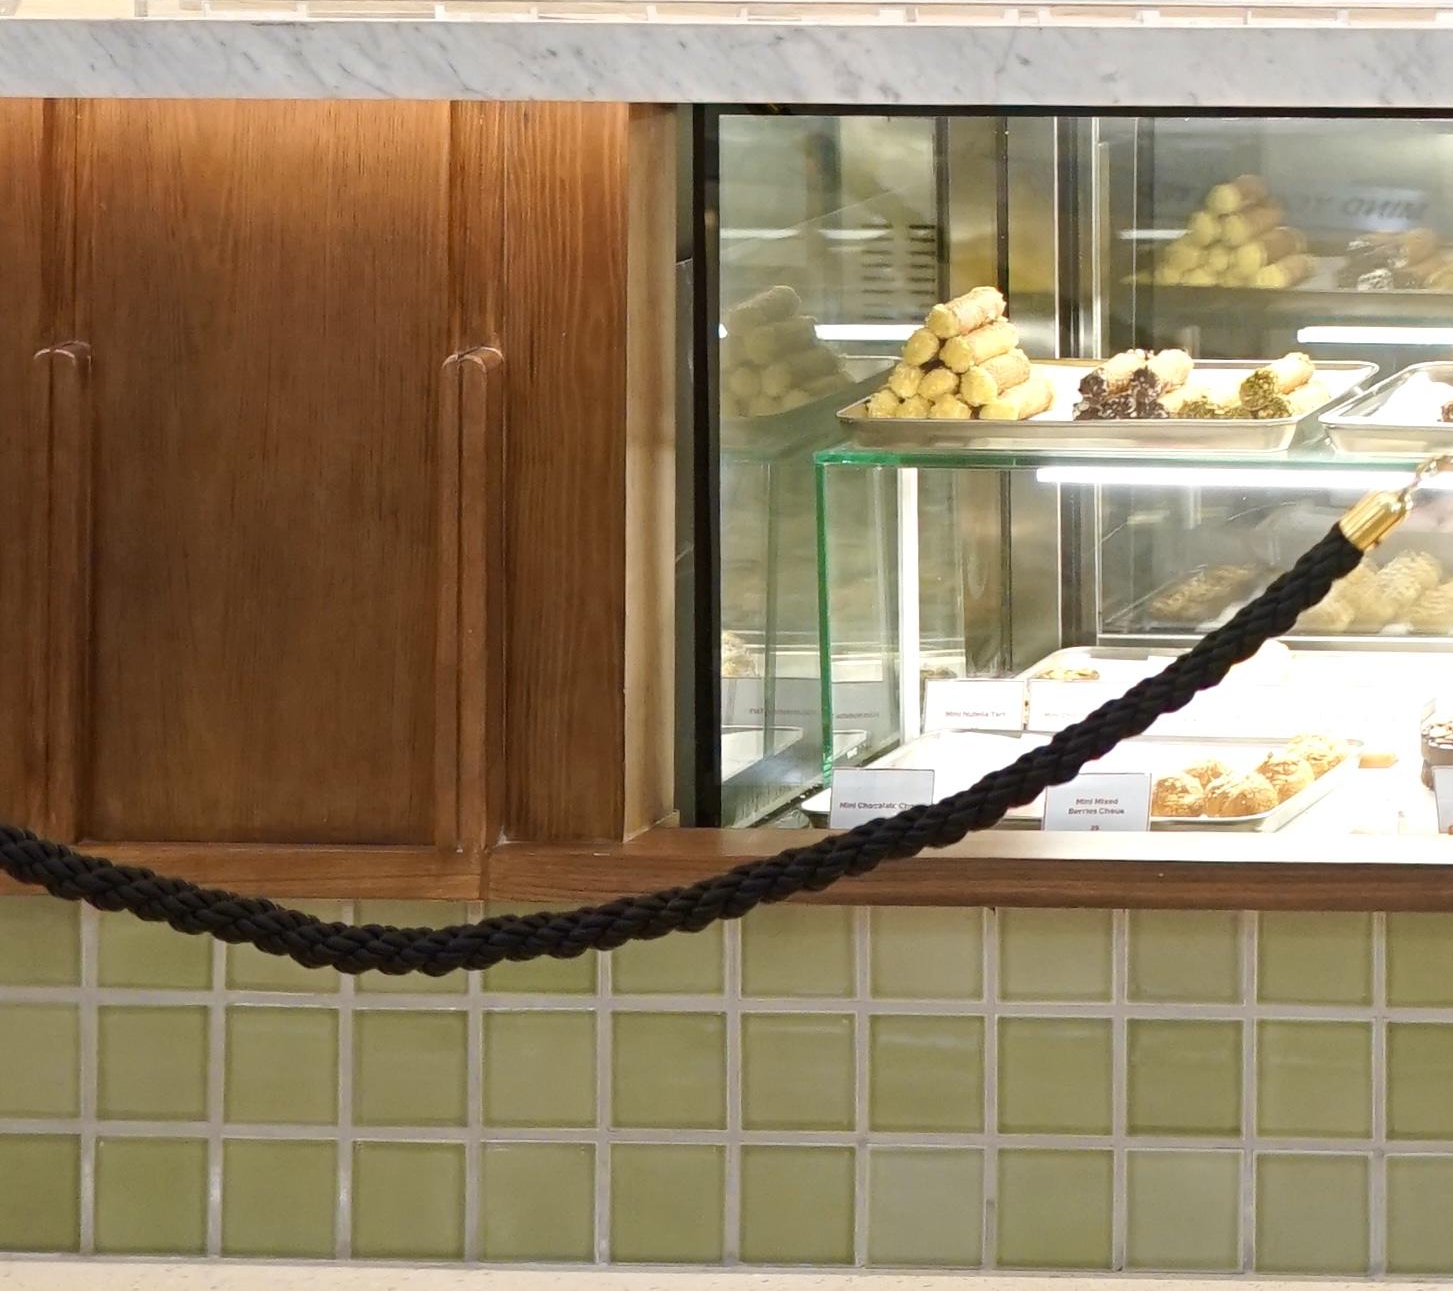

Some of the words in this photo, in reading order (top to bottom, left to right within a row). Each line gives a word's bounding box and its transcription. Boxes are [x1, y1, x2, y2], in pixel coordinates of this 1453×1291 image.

[839, 801, 857, 810] Mini
[857, 801, 896, 810] Chocolate
[1067, 807, 1098, 815] Berries
